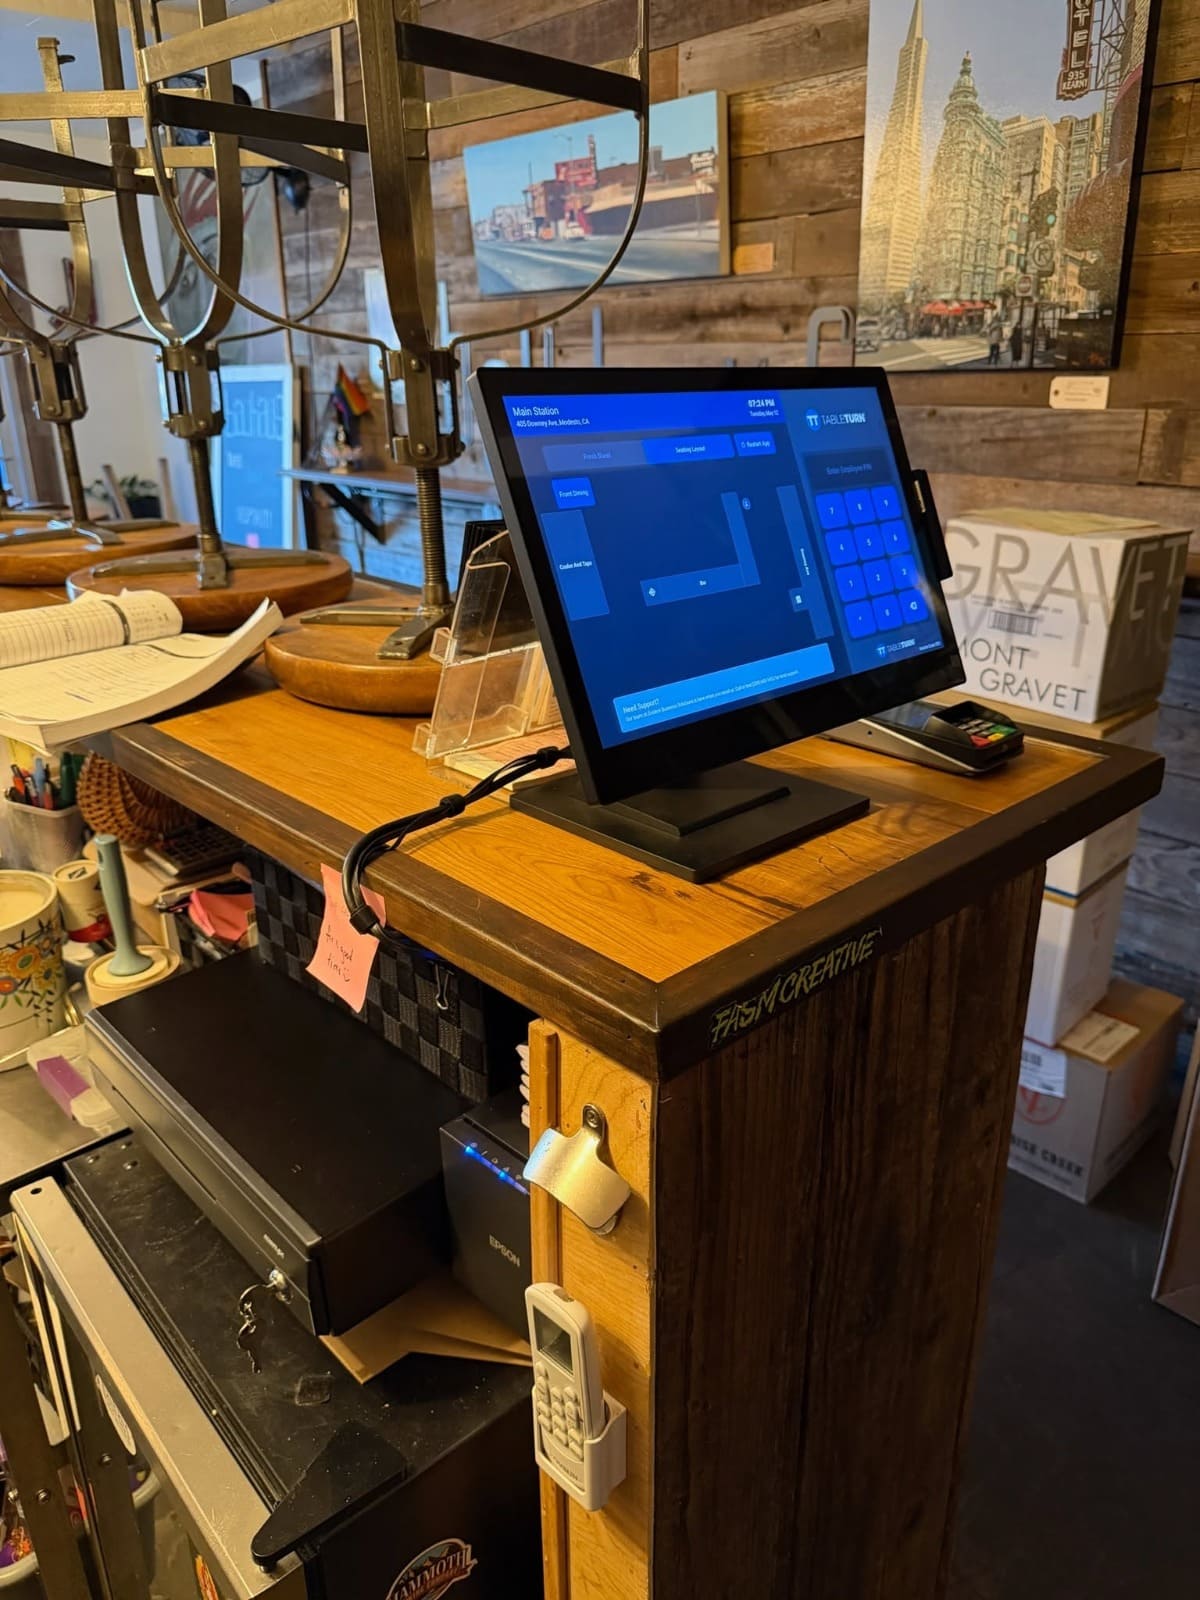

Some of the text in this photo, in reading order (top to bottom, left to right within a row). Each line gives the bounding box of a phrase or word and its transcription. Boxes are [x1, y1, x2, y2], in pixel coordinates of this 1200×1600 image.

[1067, 69, 1086, 81] 935
[1062, 79, 1089, 90] KEARNY
[748, 398, 776, 408] 07:24 PM
[512, 406, 559, 416] Main Station
[821, 412, 867, 425] TABLETURN
[980, 667, 1087, 712] GRAVET
[622, 704, 637, 714] Need
[489, 1233, 521, 1269] EPSON
